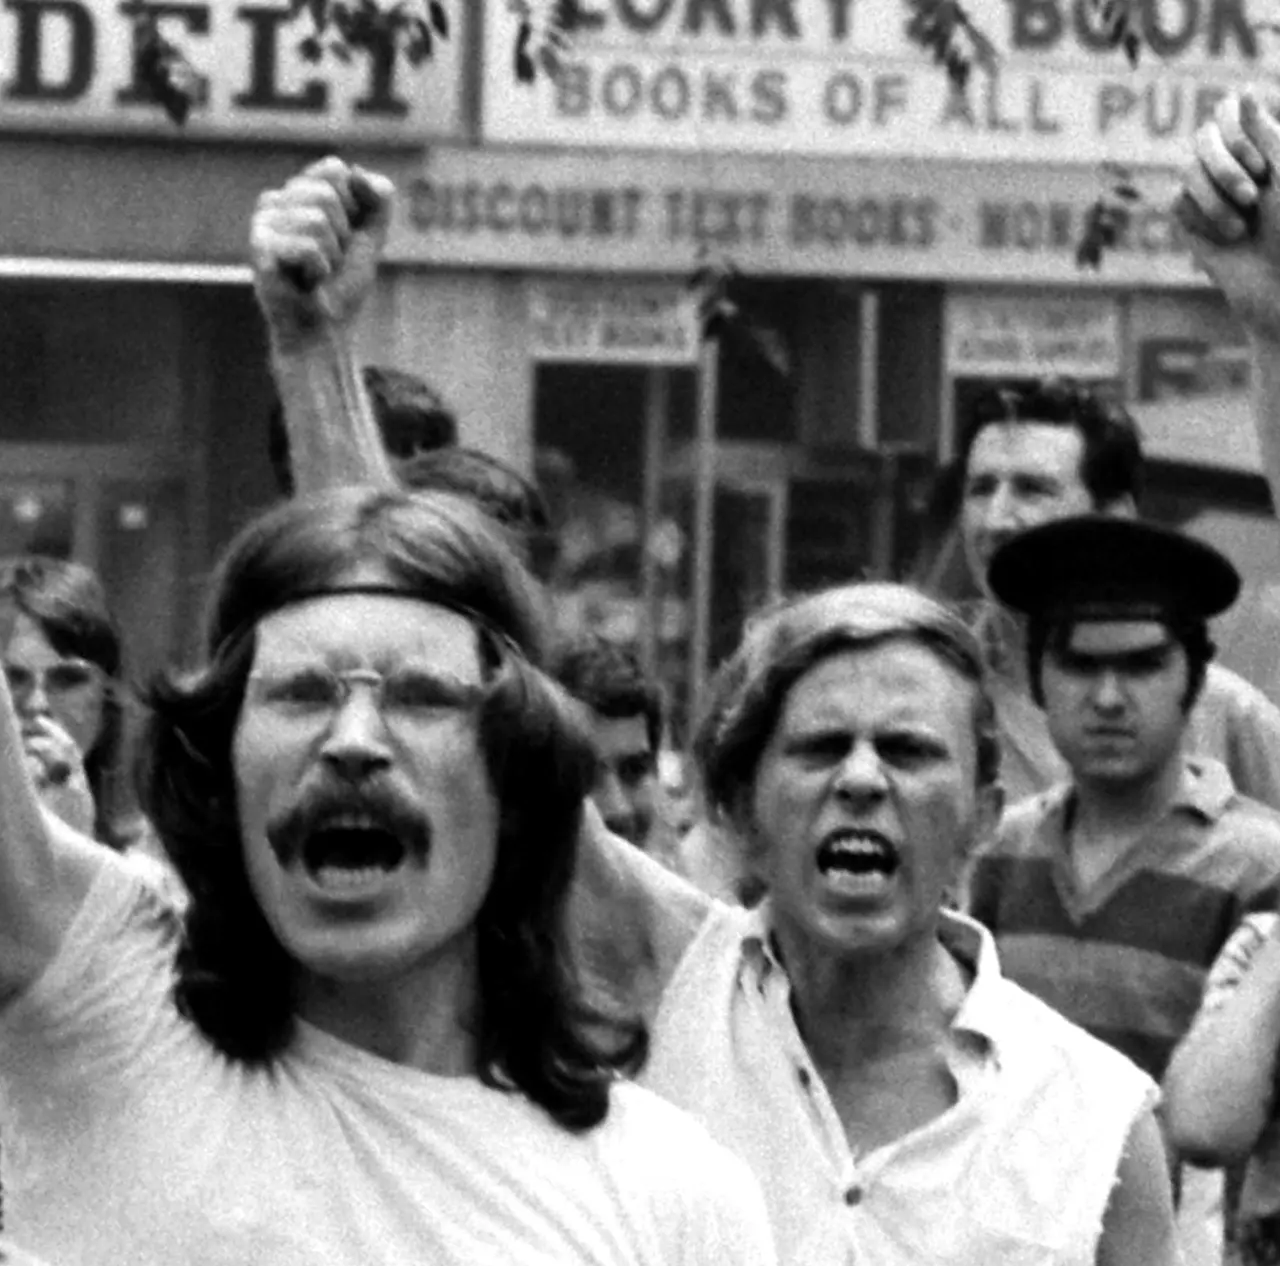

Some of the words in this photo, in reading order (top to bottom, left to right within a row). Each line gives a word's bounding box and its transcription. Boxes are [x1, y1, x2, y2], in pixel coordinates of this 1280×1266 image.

[556, 63, 788, 124] BOOKS
[824, 71, 908, 126] OF
[408, 178, 640, 239] DISCOUNT
[665, 188, 769, 243] TEXT
[790, 194, 935, 249] BOOKS
